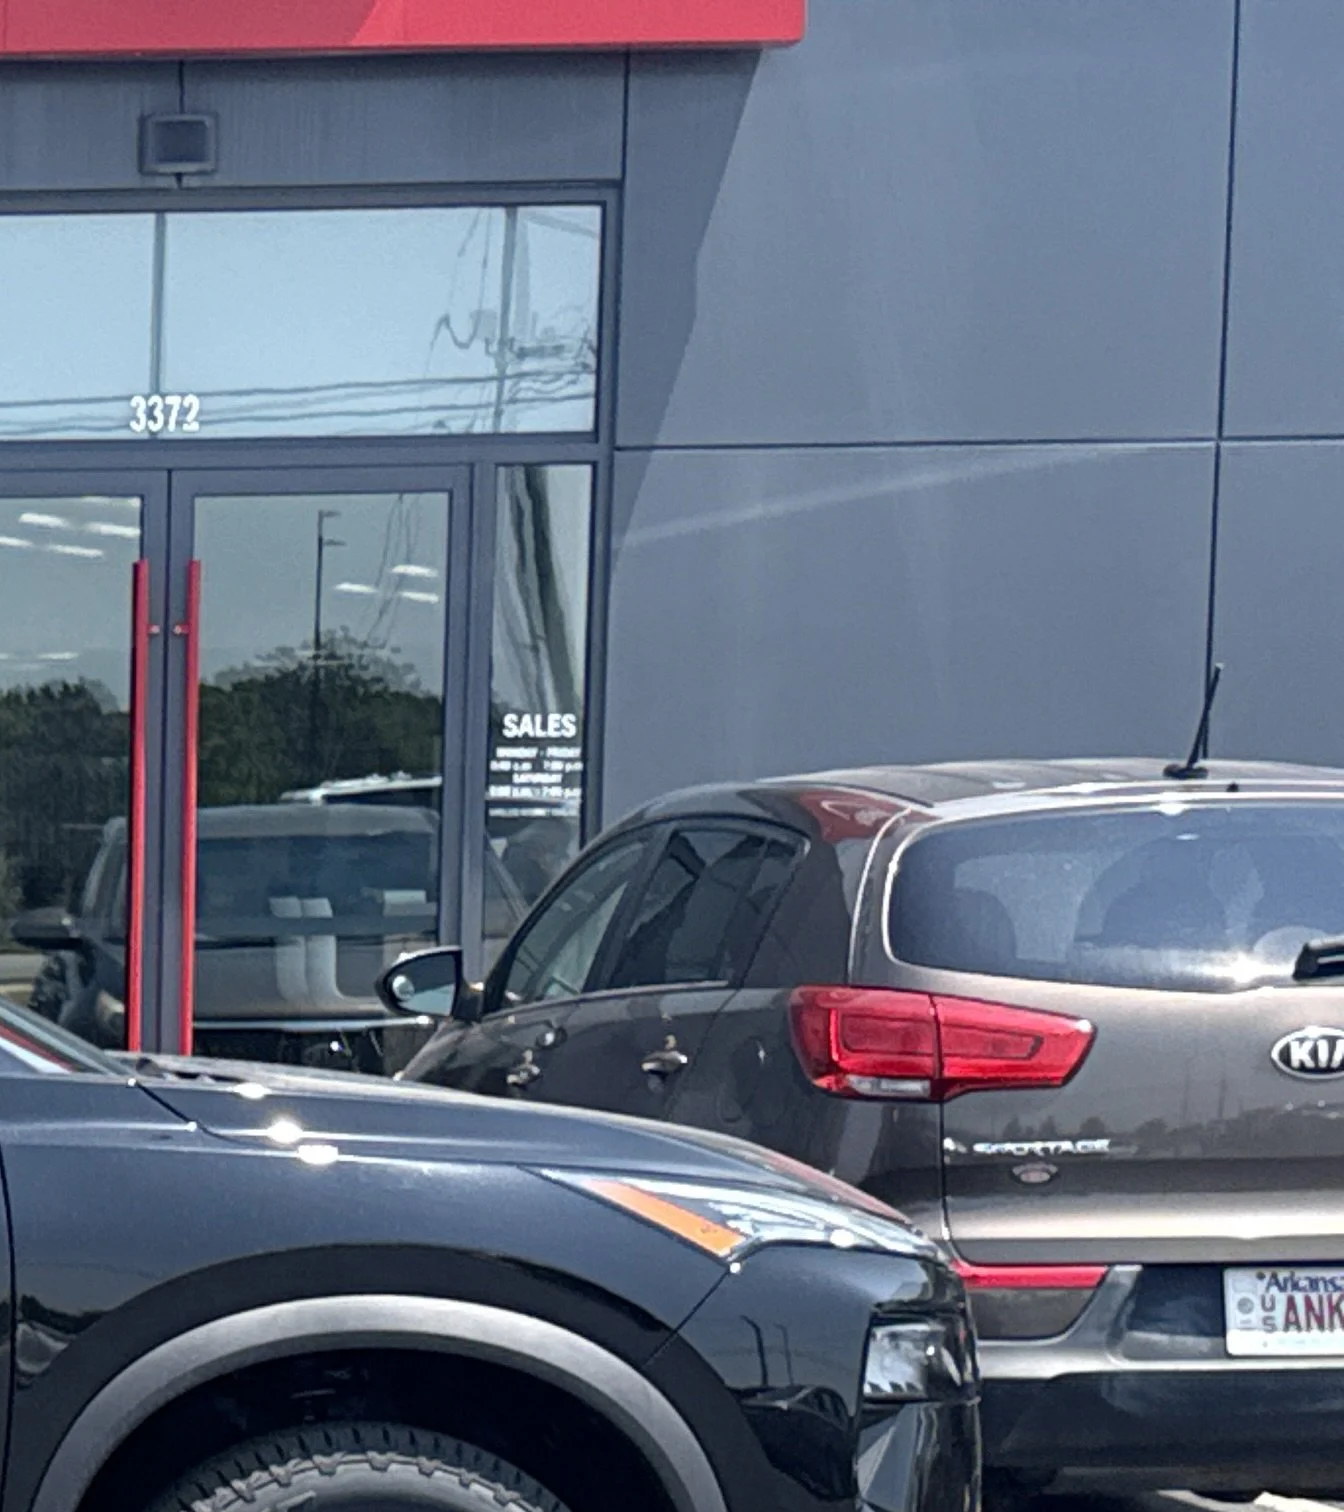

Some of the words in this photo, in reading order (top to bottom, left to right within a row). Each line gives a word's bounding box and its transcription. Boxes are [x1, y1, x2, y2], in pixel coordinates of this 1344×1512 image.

[130, 393, 200, 432] 3372
[502, 713, 577, 738] SALES
[1264, 1270, 1344, 1293] Arkans
